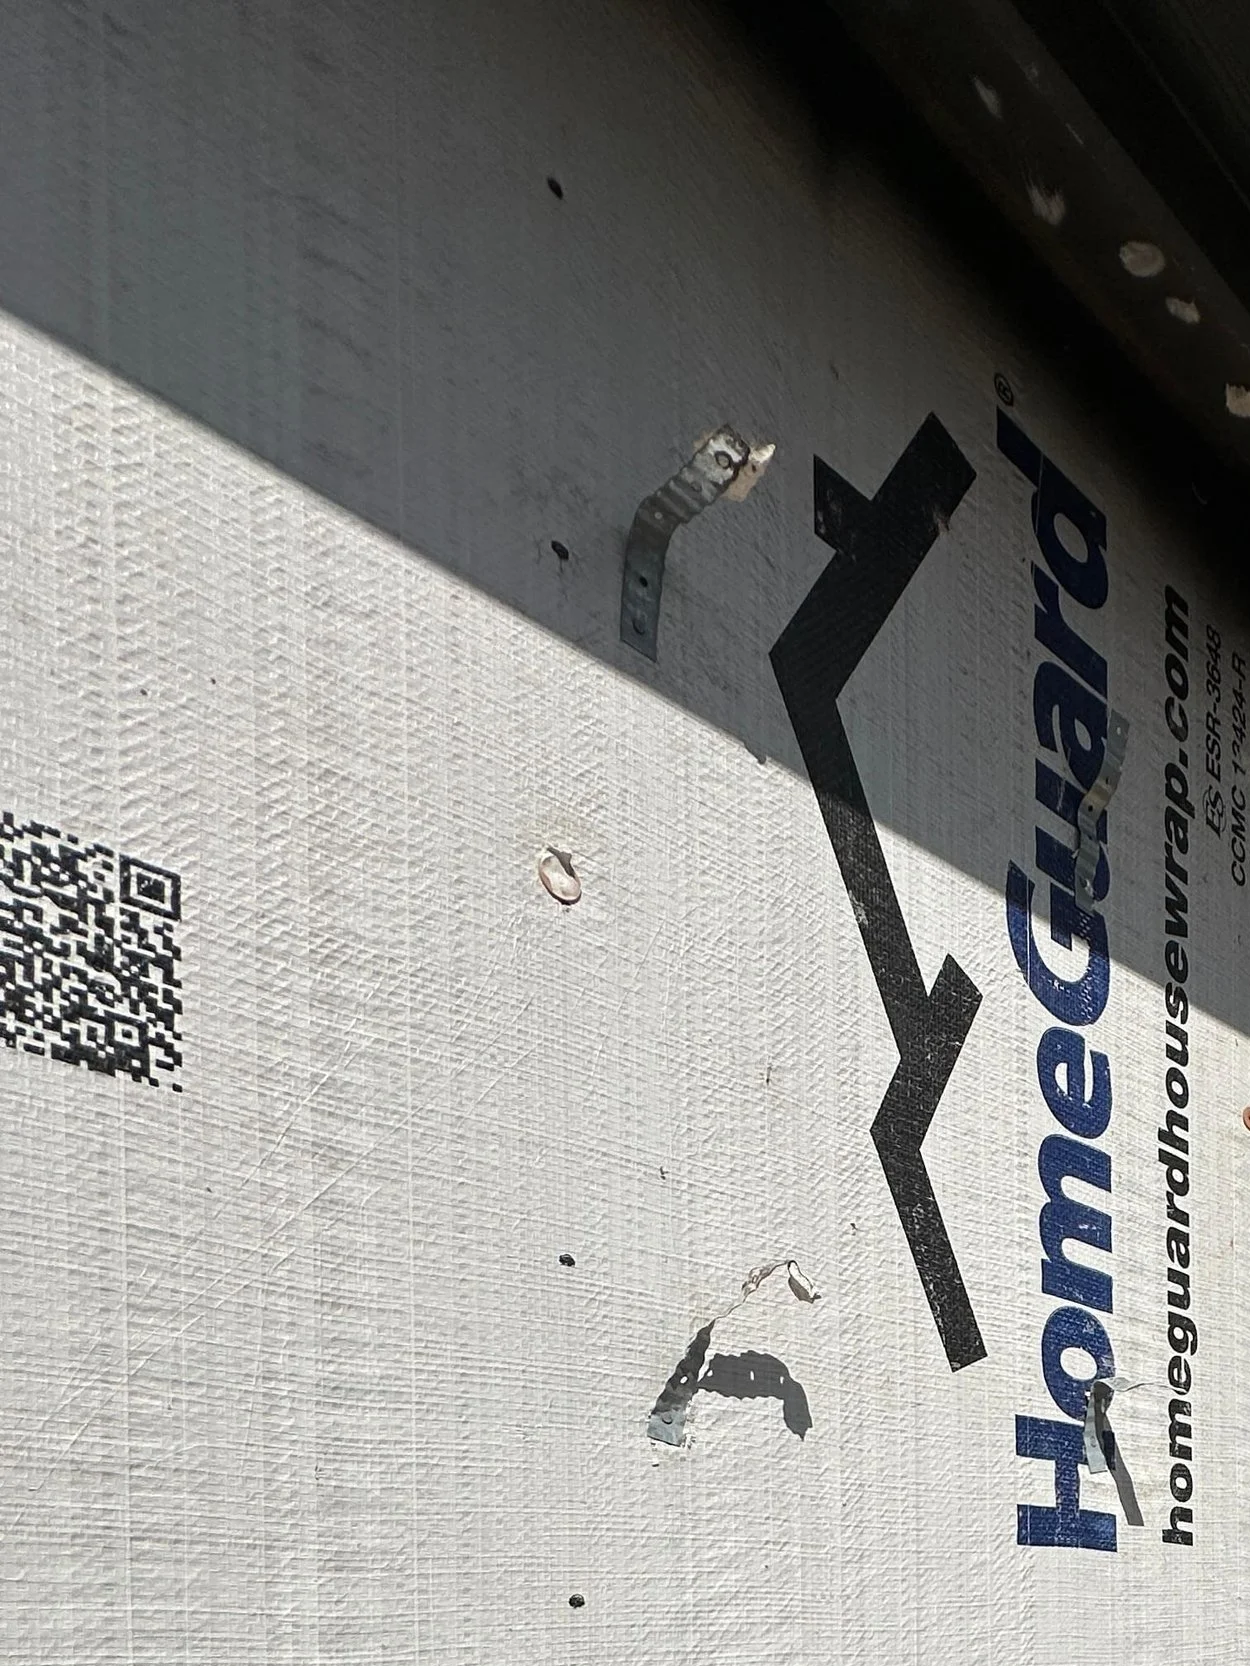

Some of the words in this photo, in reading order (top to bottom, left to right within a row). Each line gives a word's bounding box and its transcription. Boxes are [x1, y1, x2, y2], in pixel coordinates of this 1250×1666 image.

[1205, 624, 1222, 782] ESR-3648
[1231, 785, 1246, 887] CCMC
[1156, 584, 1198, 1546] homeguardhousewrap.com
